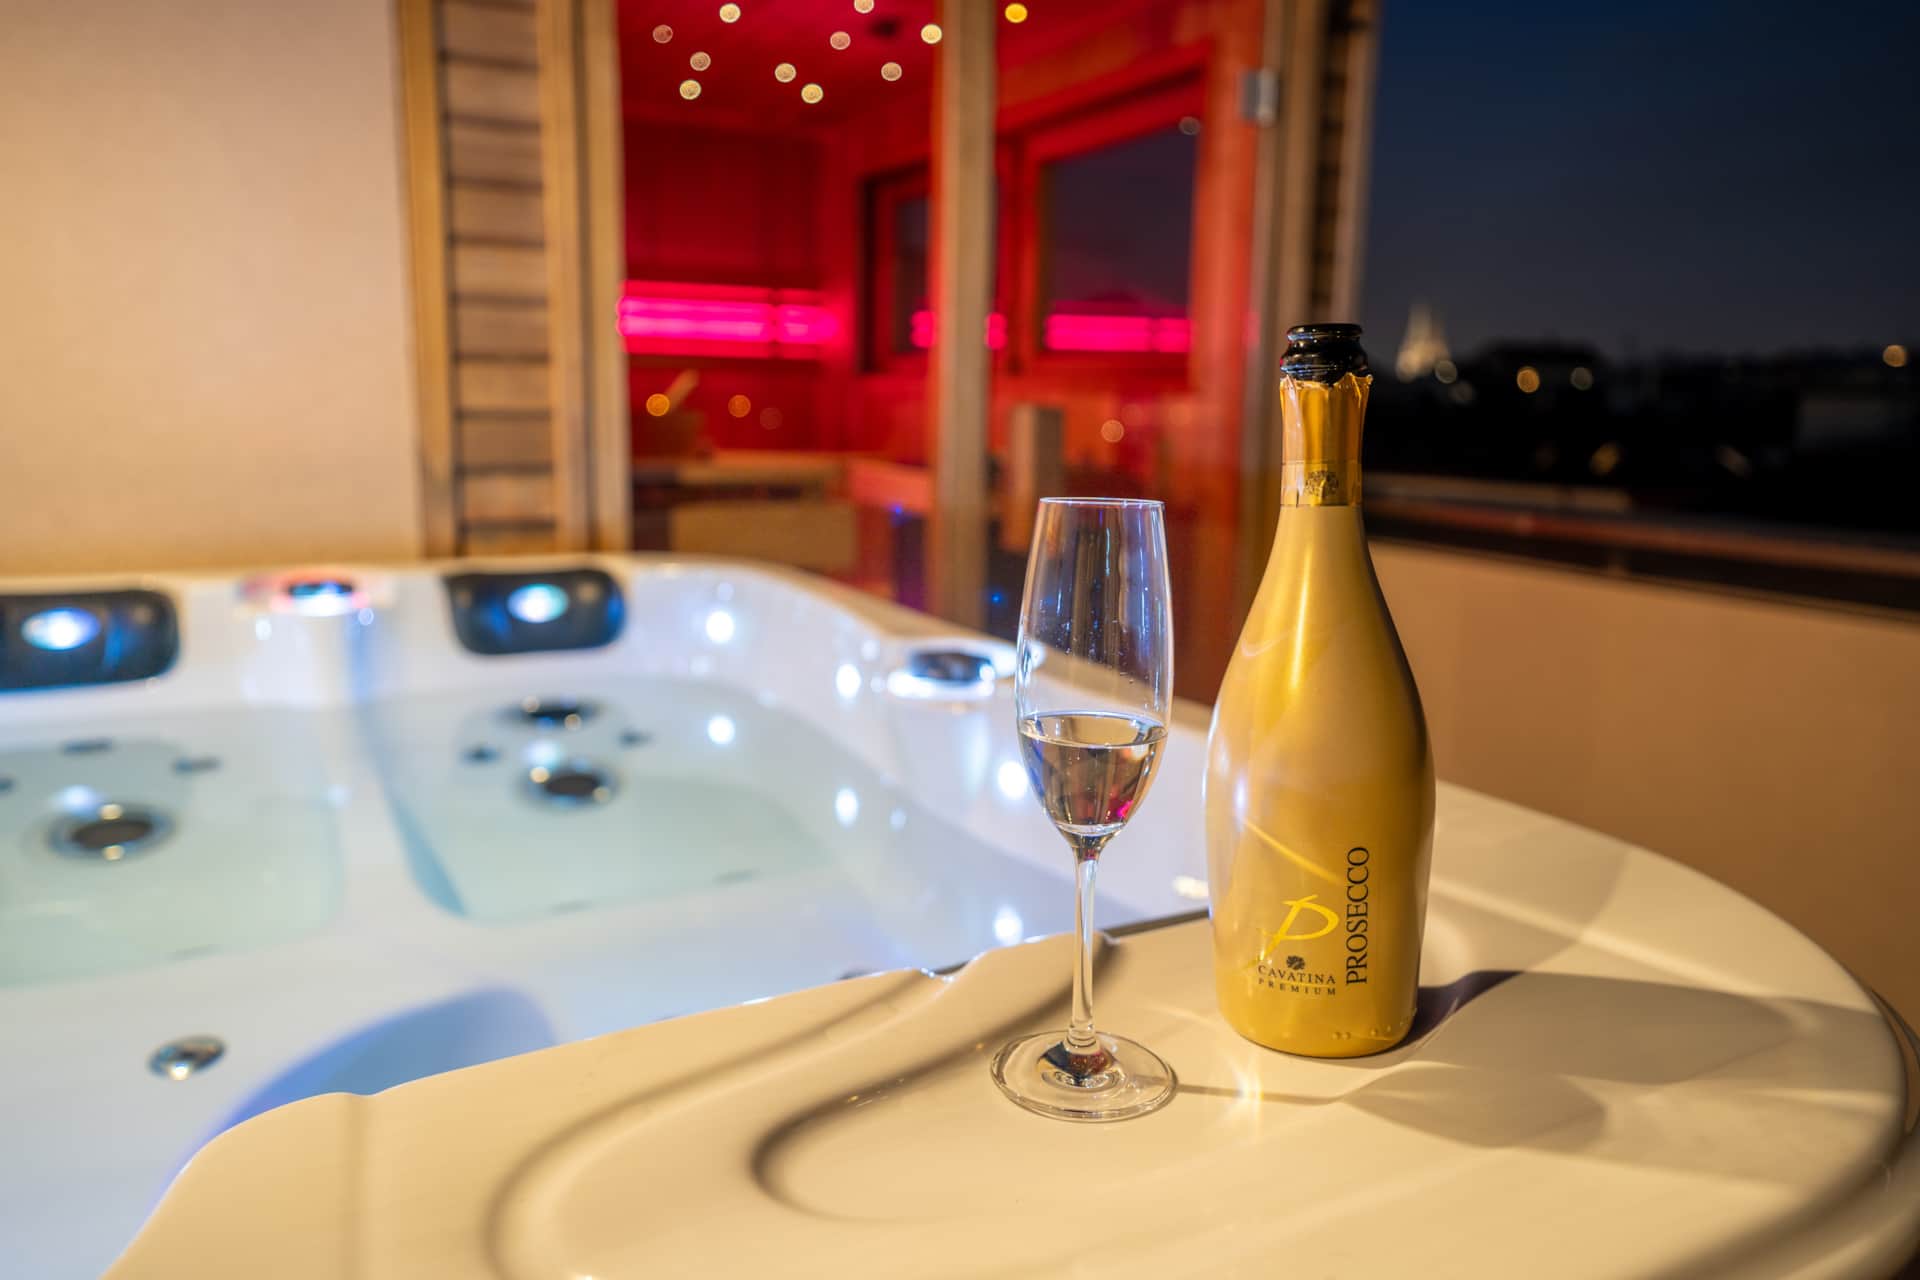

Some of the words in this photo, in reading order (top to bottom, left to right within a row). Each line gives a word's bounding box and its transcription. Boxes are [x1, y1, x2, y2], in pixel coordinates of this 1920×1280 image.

[1345, 846, 1370, 986] PROSECCO
[1257, 964, 1336, 985] CAVATINA
[1258, 978, 1336, 996] PREMIUM
